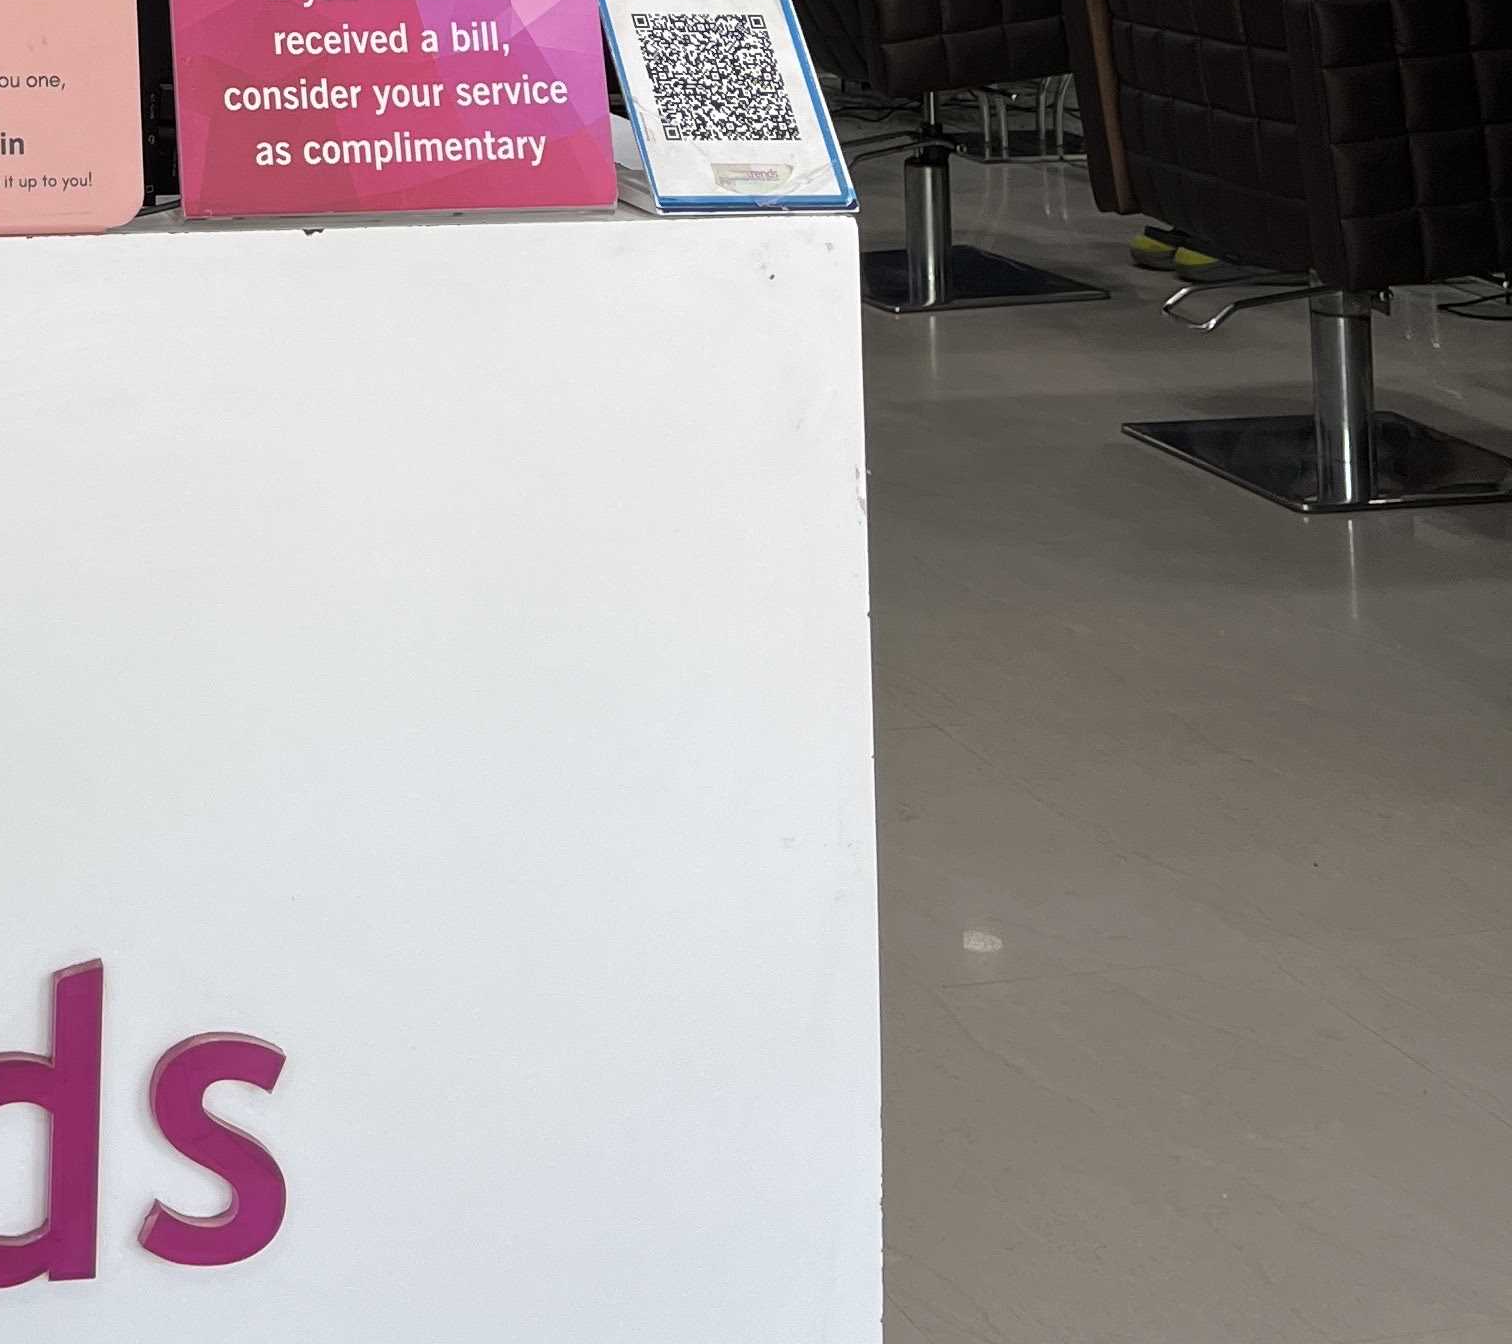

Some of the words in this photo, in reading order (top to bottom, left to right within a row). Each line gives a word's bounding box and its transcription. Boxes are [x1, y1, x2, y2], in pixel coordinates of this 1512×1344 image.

[273, 23, 408, 55] received
[421, 30, 440, 54] a
[451, 21, 511, 57] bill,
[26, 74, 67, 92] one,
[224, 78, 362, 112] consider
[371, 83, 444, 115] your
[455, 74, 569, 106] service
[255, 141, 291, 167] as
[303, 130, 547, 171] complimentary
[3, 174, 15, 189] it
[19, 176, 39, 194] up
[41, 174, 59, 189] to
[61, 172, 94, 193] you!
